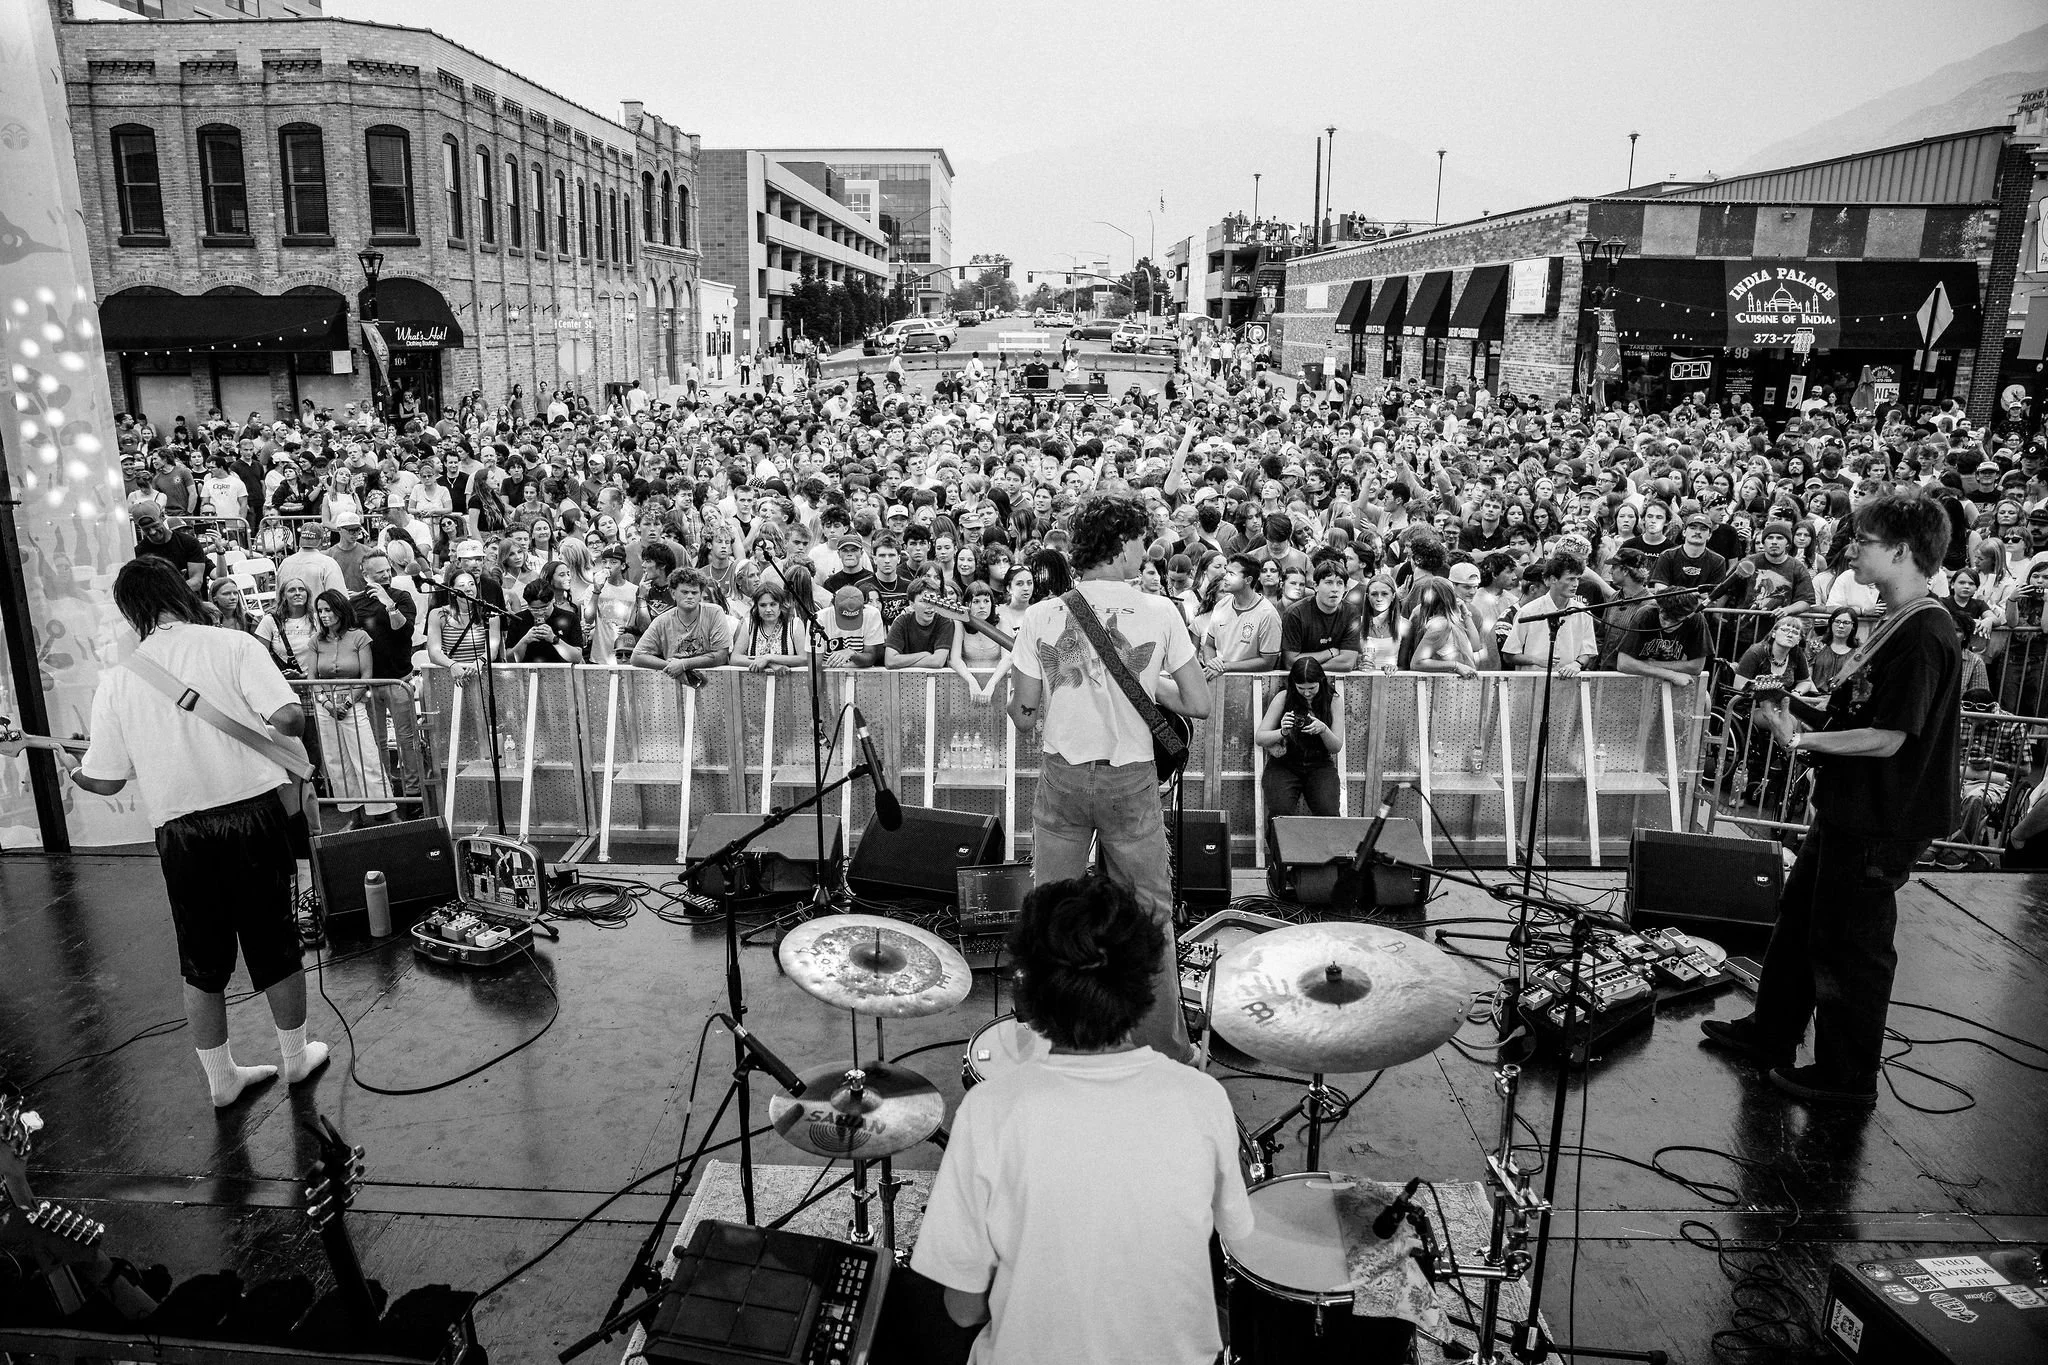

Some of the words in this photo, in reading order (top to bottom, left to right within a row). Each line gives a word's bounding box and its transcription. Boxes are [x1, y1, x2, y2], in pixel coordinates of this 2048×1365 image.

[1729, 269, 1771, 301] INDIA
[1776, 267, 1836, 301] PALACE
[1735, 312, 1778, 324] CUISINE
[1781, 314, 1796, 324] OF
[1801, 313, 1832, 324] INDIA
[558, 320, 582, 329] Center
[395, 325, 424, 341] What's
[424, 326, 448, 341] Hot!
[1753, 333, 1816, 344] 373-72
[1734, 347, 1750, 359] 98
[1672, 363, 1710, 378] OPEN
[805, 1110, 887, 1135] SAN
[1931, 1258, 1974, 1267] TODAY
[1931, 1267, 1995, 1277] SOMEONE
[1959, 1278, 1990, 1287] HUG
